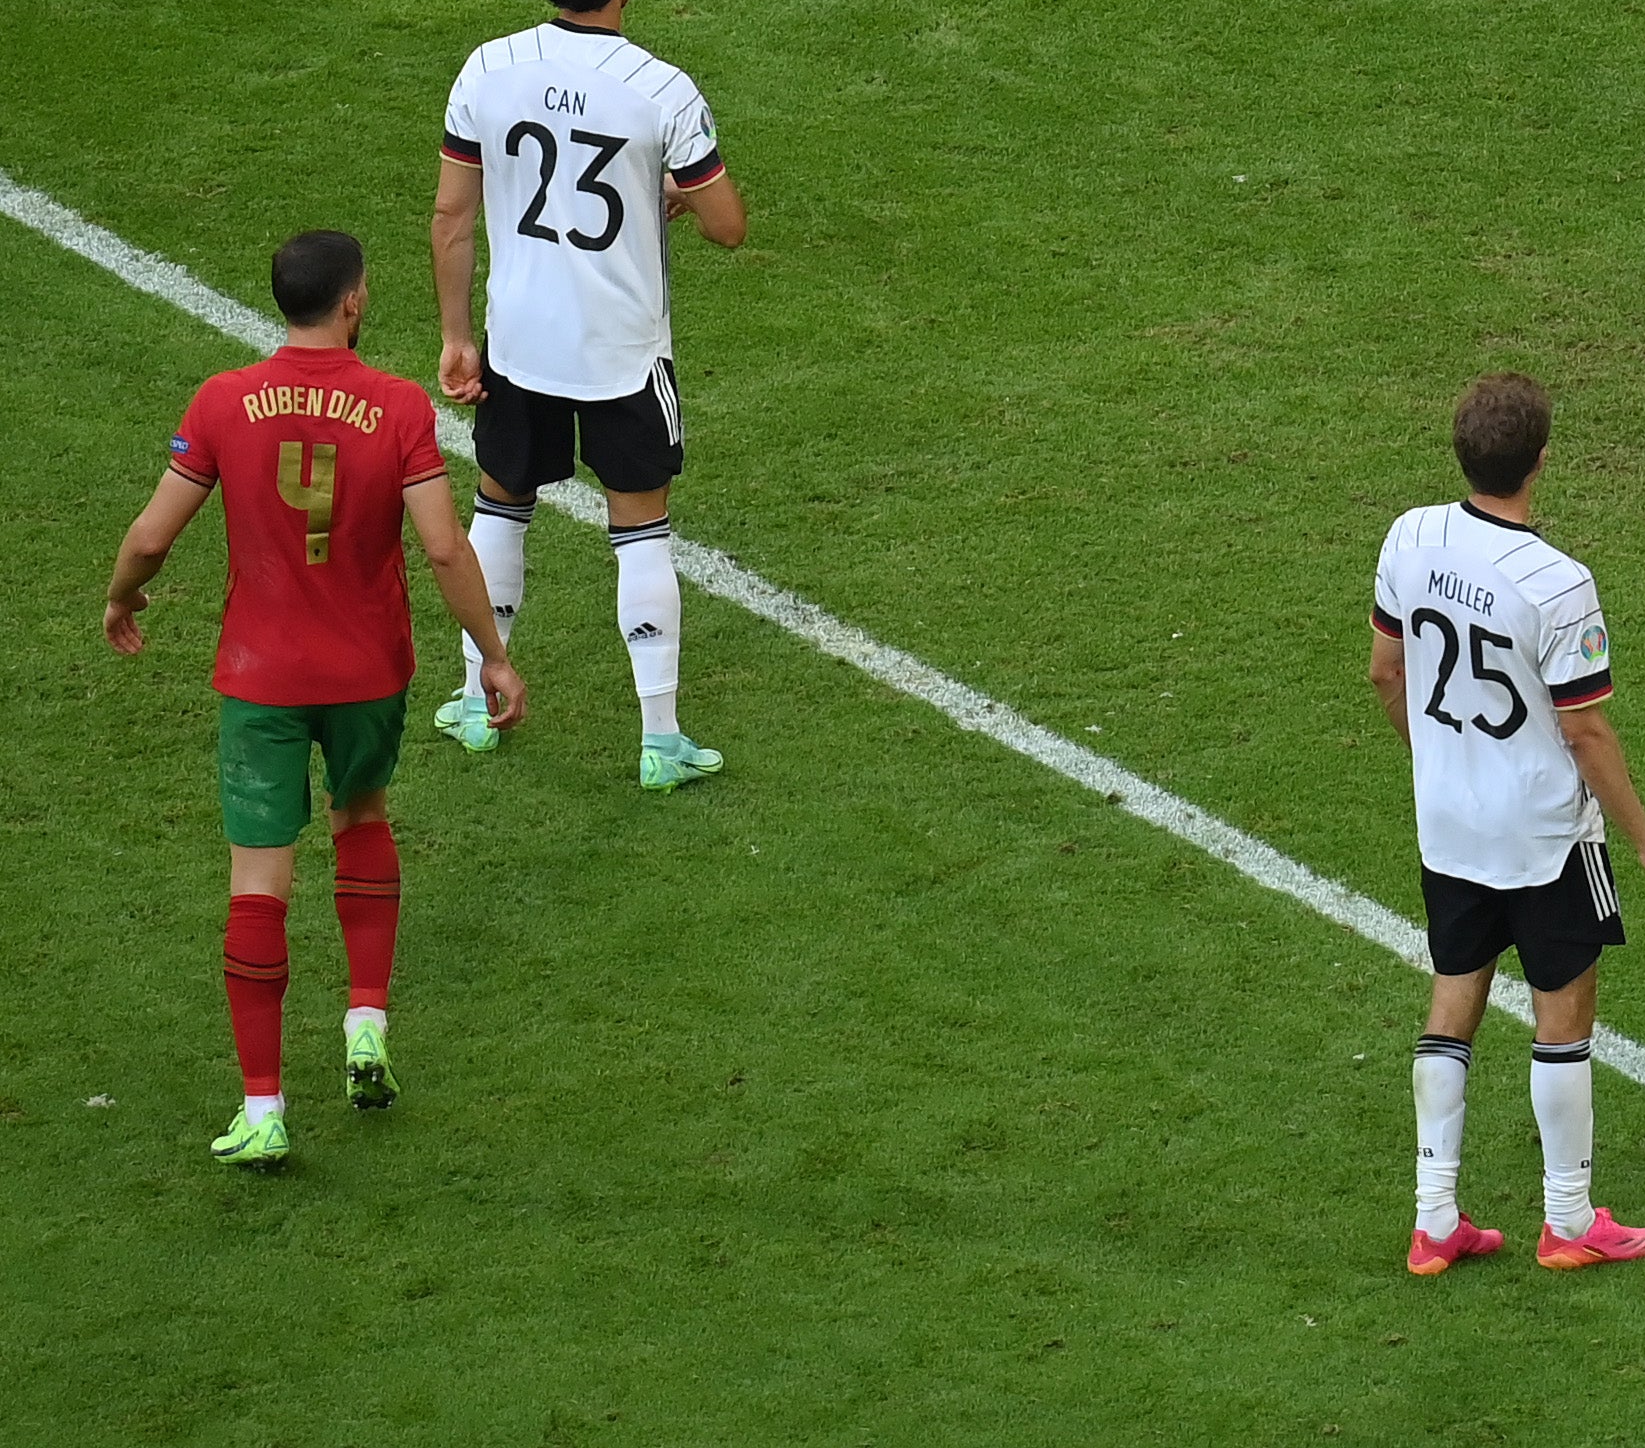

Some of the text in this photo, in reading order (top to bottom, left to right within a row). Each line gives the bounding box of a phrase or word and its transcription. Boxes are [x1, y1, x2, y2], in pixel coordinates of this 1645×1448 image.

[544, 86, 587, 116] CAN
[505, 120, 630, 252] 23
[242, 381, 383, 434] RÚBEN DIAS
[276, 441, 337, 565] 4
[1427, 569, 1495, 617] MÜLLER
[1411, 607, 1528, 740] 25
